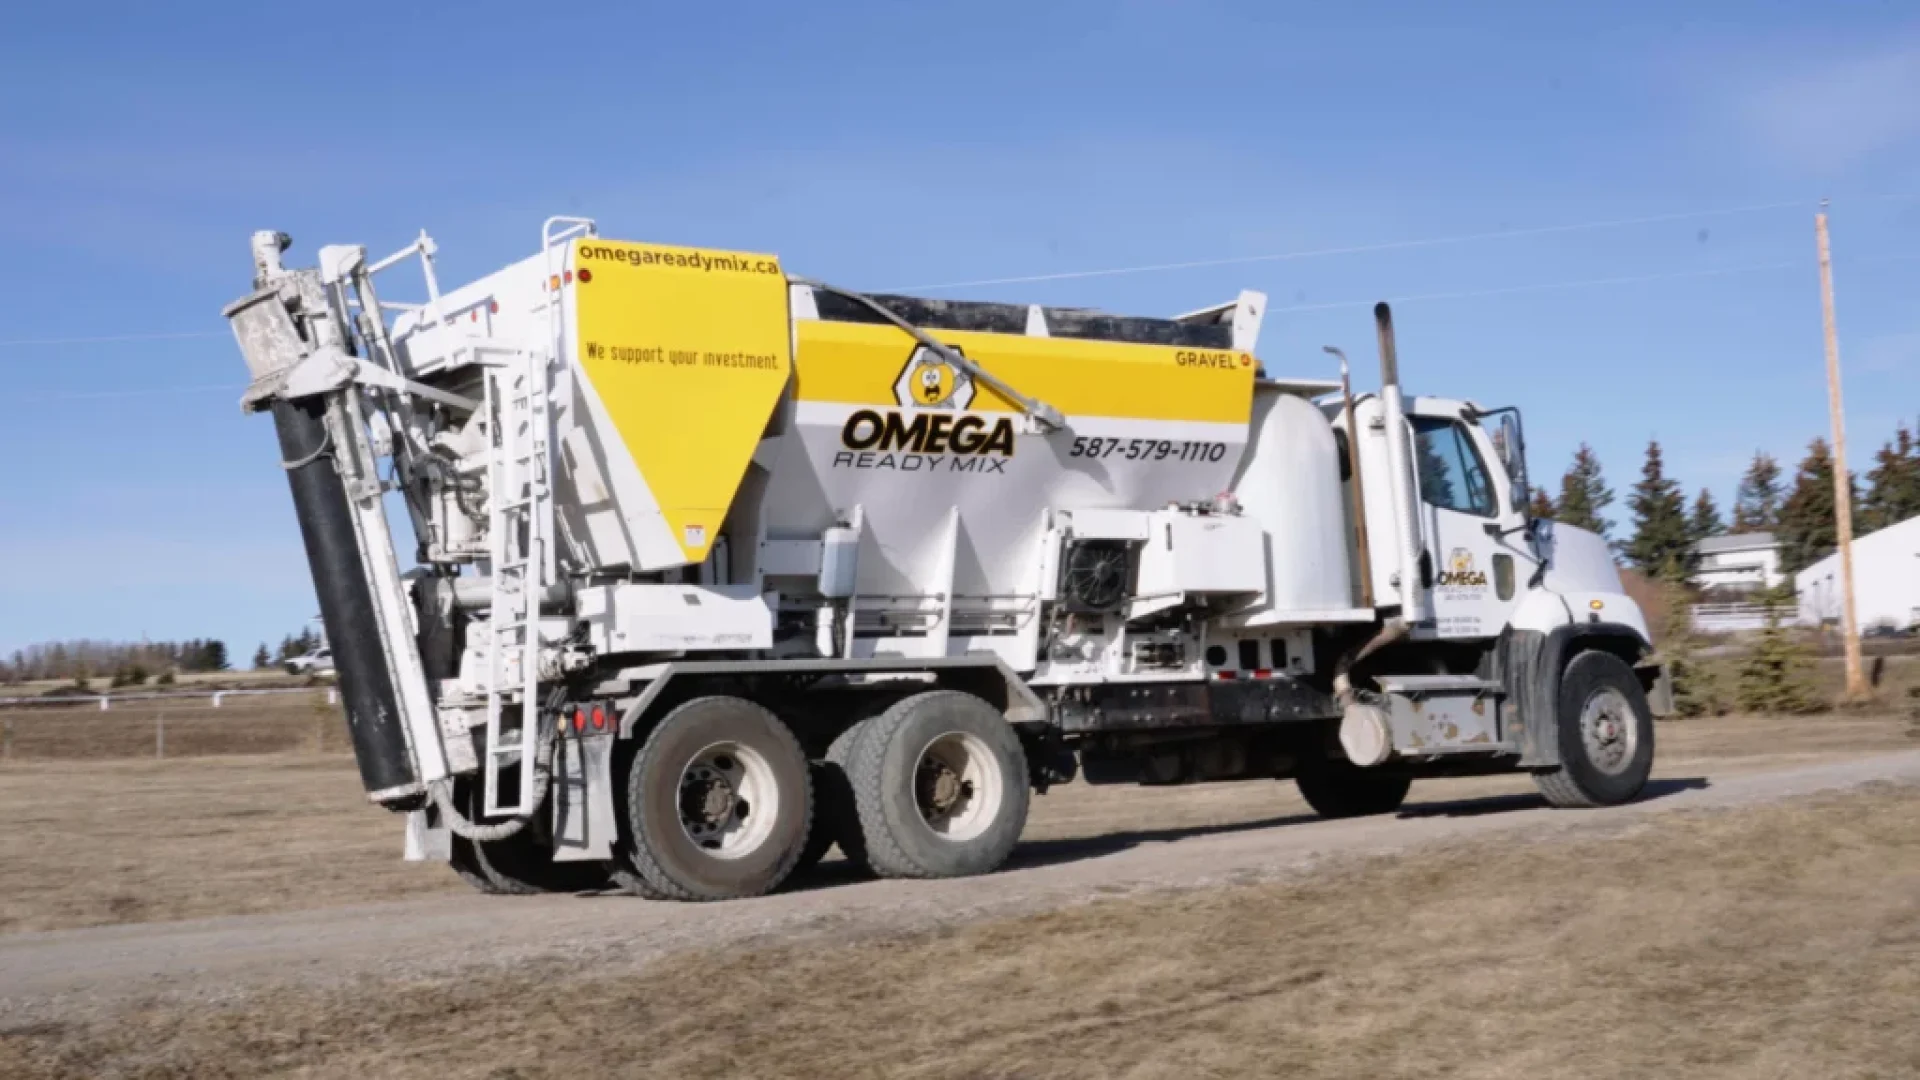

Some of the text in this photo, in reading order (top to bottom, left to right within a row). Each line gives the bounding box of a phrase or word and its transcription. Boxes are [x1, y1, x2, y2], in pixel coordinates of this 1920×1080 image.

[579, 244, 780, 275] omegareadymix.ca
[586, 341, 779, 371] We support your investment
[1175, 350, 1237, 370] GRAVEL
[841, 408, 1016, 458] OMEGA
[1069, 436, 1227, 462] 587-579-1110
[832, 451, 1009, 475] READY MIX
[1438, 570, 1488, 586] OMEGA
